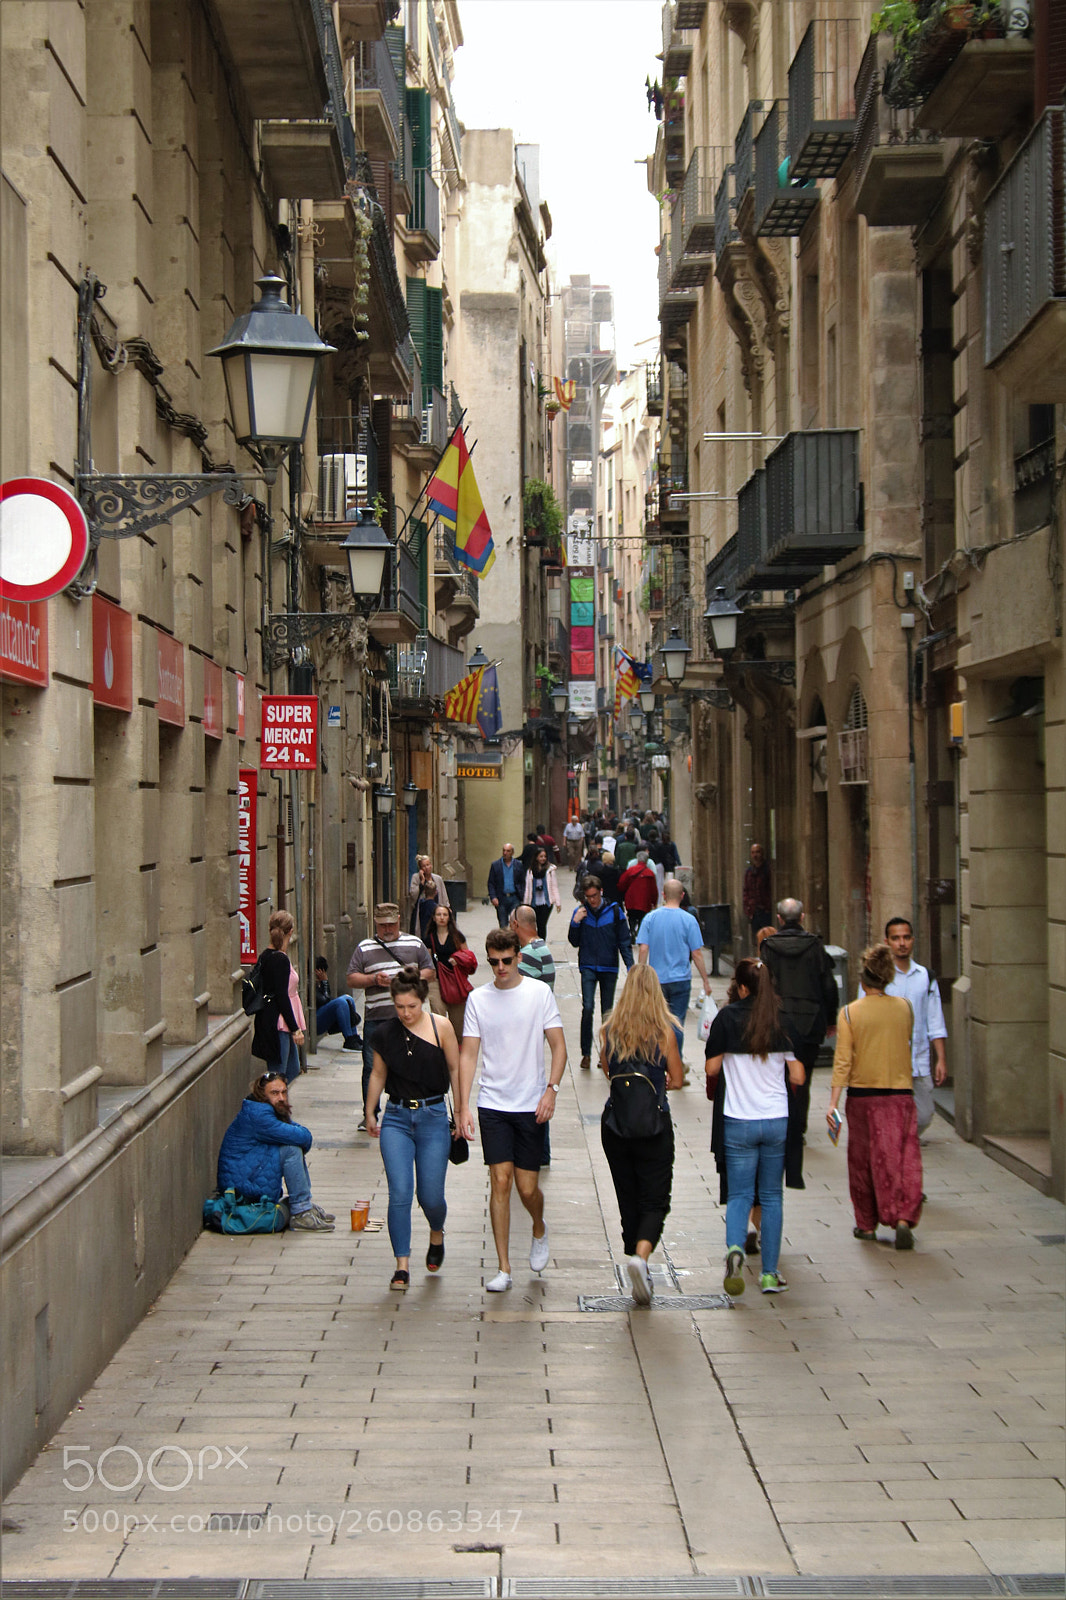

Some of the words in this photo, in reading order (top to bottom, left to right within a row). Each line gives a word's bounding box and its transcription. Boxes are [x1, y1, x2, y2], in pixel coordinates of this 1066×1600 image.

[0, 603, 40, 670] ntander
[266, 705, 312, 723] SUPER
[264, 727, 314, 745] MERCAT
[265, 746, 290, 763] 24
[294, 749, 310, 763] h.
[457, 767, 499, 777] HOTEL
